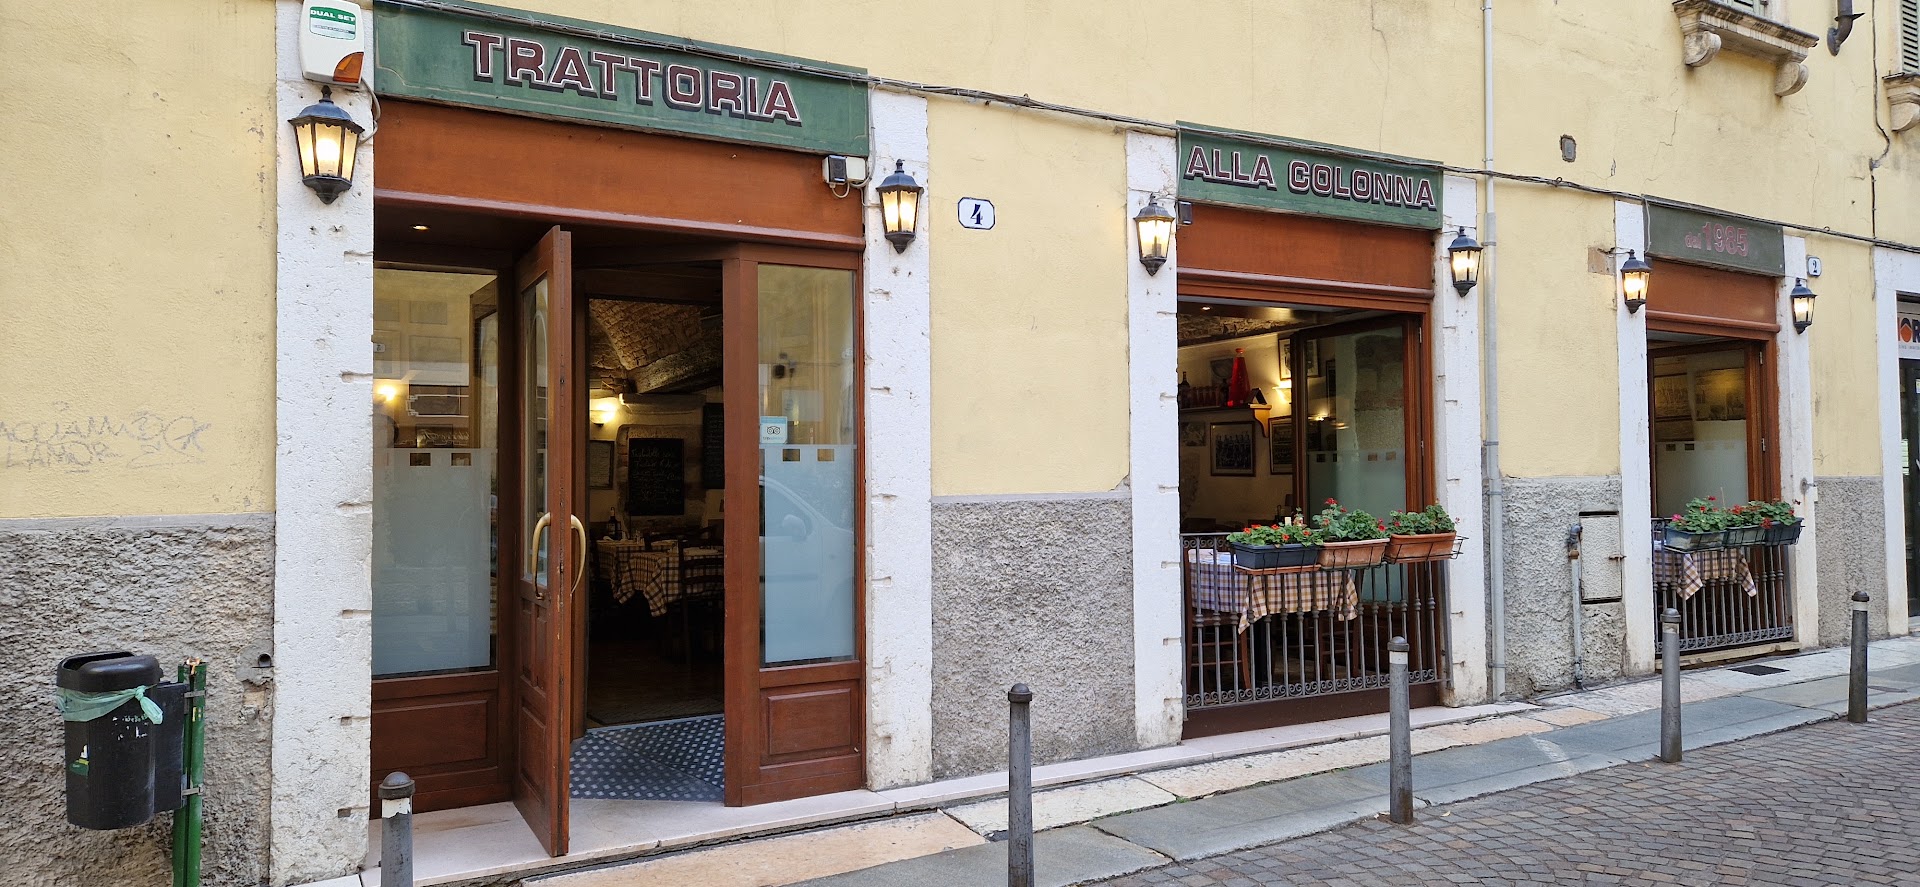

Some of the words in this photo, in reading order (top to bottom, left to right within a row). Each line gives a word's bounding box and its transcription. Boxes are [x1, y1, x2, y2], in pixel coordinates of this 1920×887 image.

[310, 10, 336, 18] DUAL
[462, 30, 801, 125] TRATTORIA
[1185, 145, 1276, 190] ALLA
[1288, 160, 1436, 209] COLONNA
[970, 203, 983, 225] 4
[1685, 231, 1702, 250] dal
[1702, 221, 1748, 257] 1985
